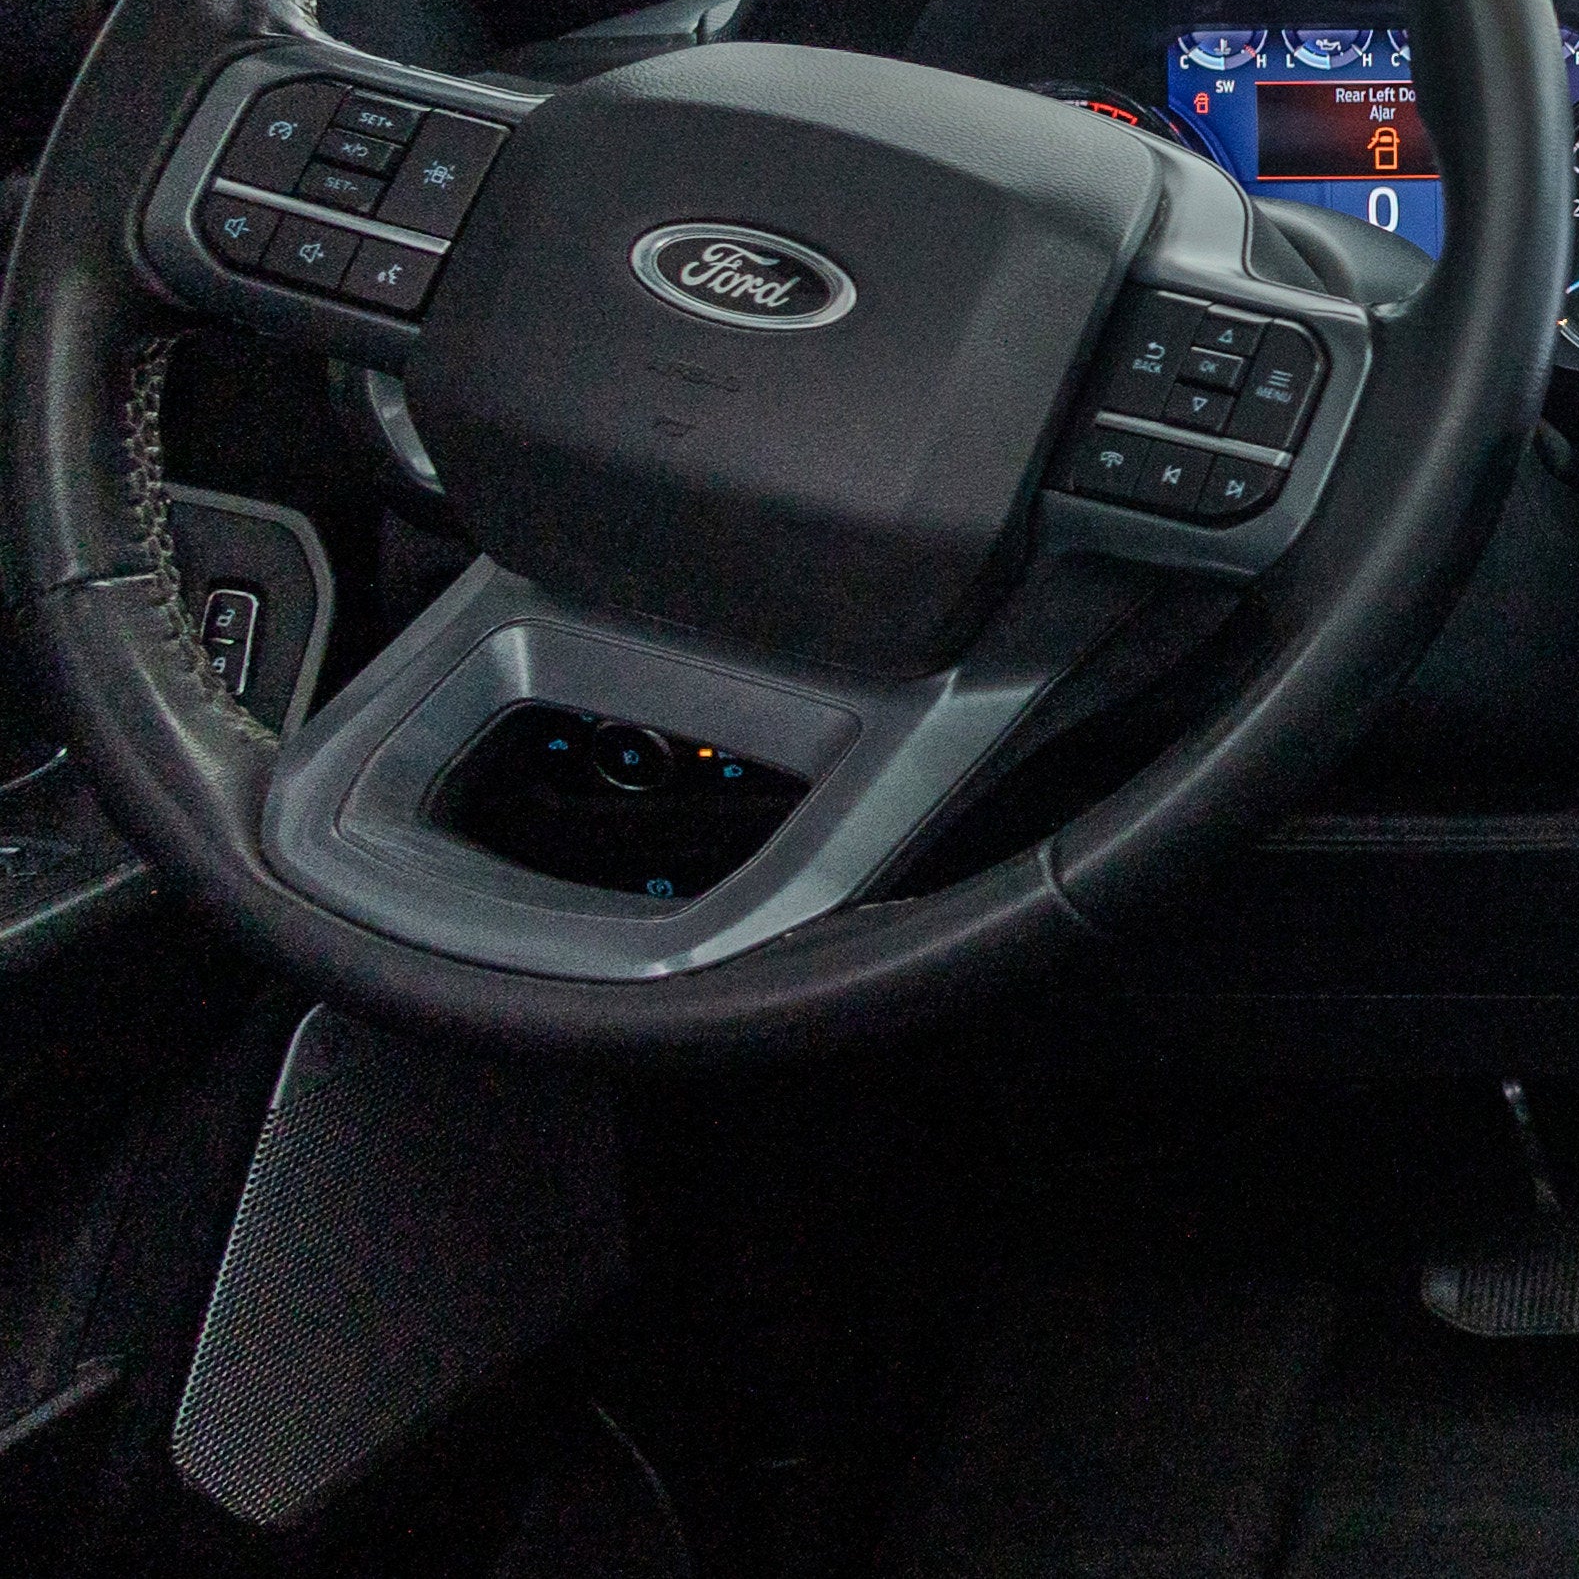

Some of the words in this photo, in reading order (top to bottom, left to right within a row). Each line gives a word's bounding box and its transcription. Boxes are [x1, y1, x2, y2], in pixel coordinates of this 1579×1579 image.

[1215, 80, 1236, 94] SW
[1335, 88, 1367, 103] Rear
[1368, 87, 1396, 103] Left
[1369, 104, 1396, 122] Ajar
[680, 243, 801, 308] Ford
